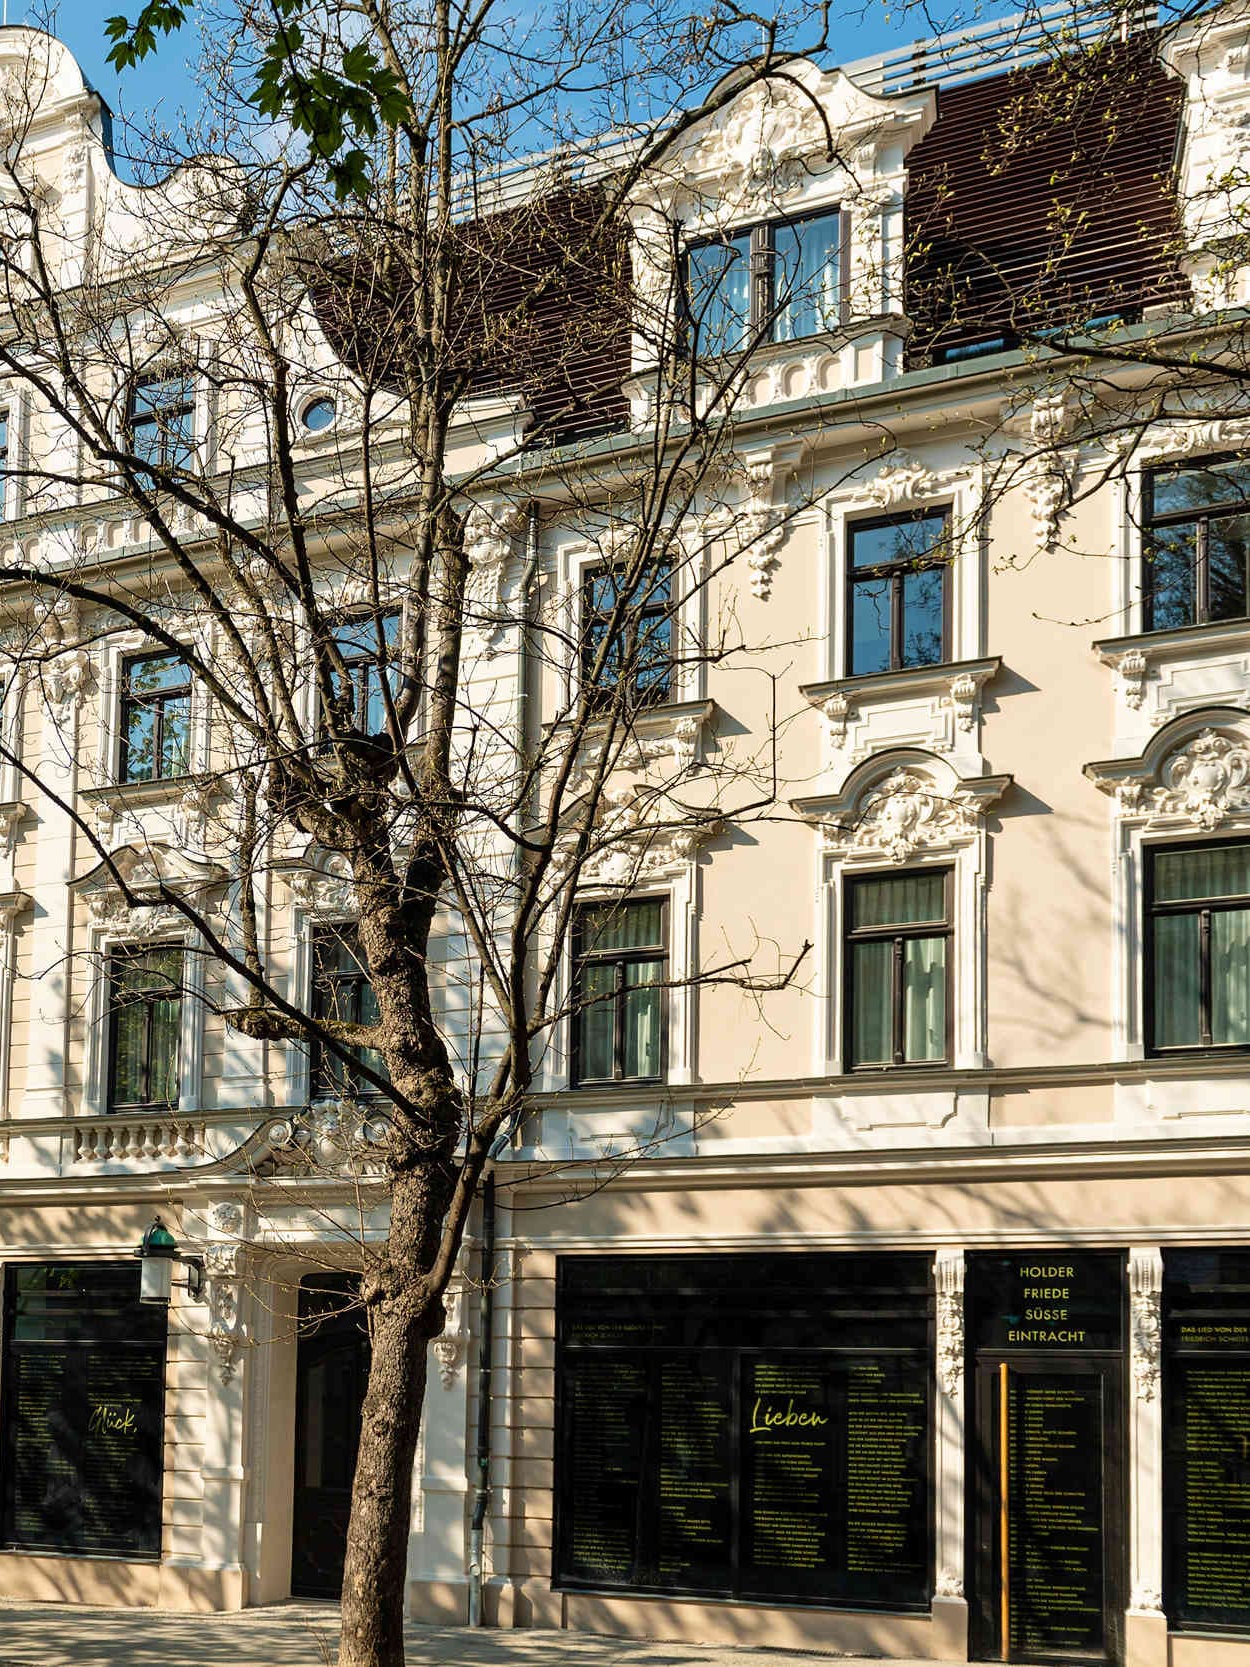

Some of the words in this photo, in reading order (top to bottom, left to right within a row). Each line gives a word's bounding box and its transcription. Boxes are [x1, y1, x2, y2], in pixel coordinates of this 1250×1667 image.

[1020, 1267, 1074, 1277] HOLDER
[1023, 1288, 1069, 1299] FRIEDE
[1025, 1306, 1068, 1320] SÜSSE
[1008, 1331, 1086, 1342] EINTRACHT
[750, 1398, 829, 1433] Lieben
